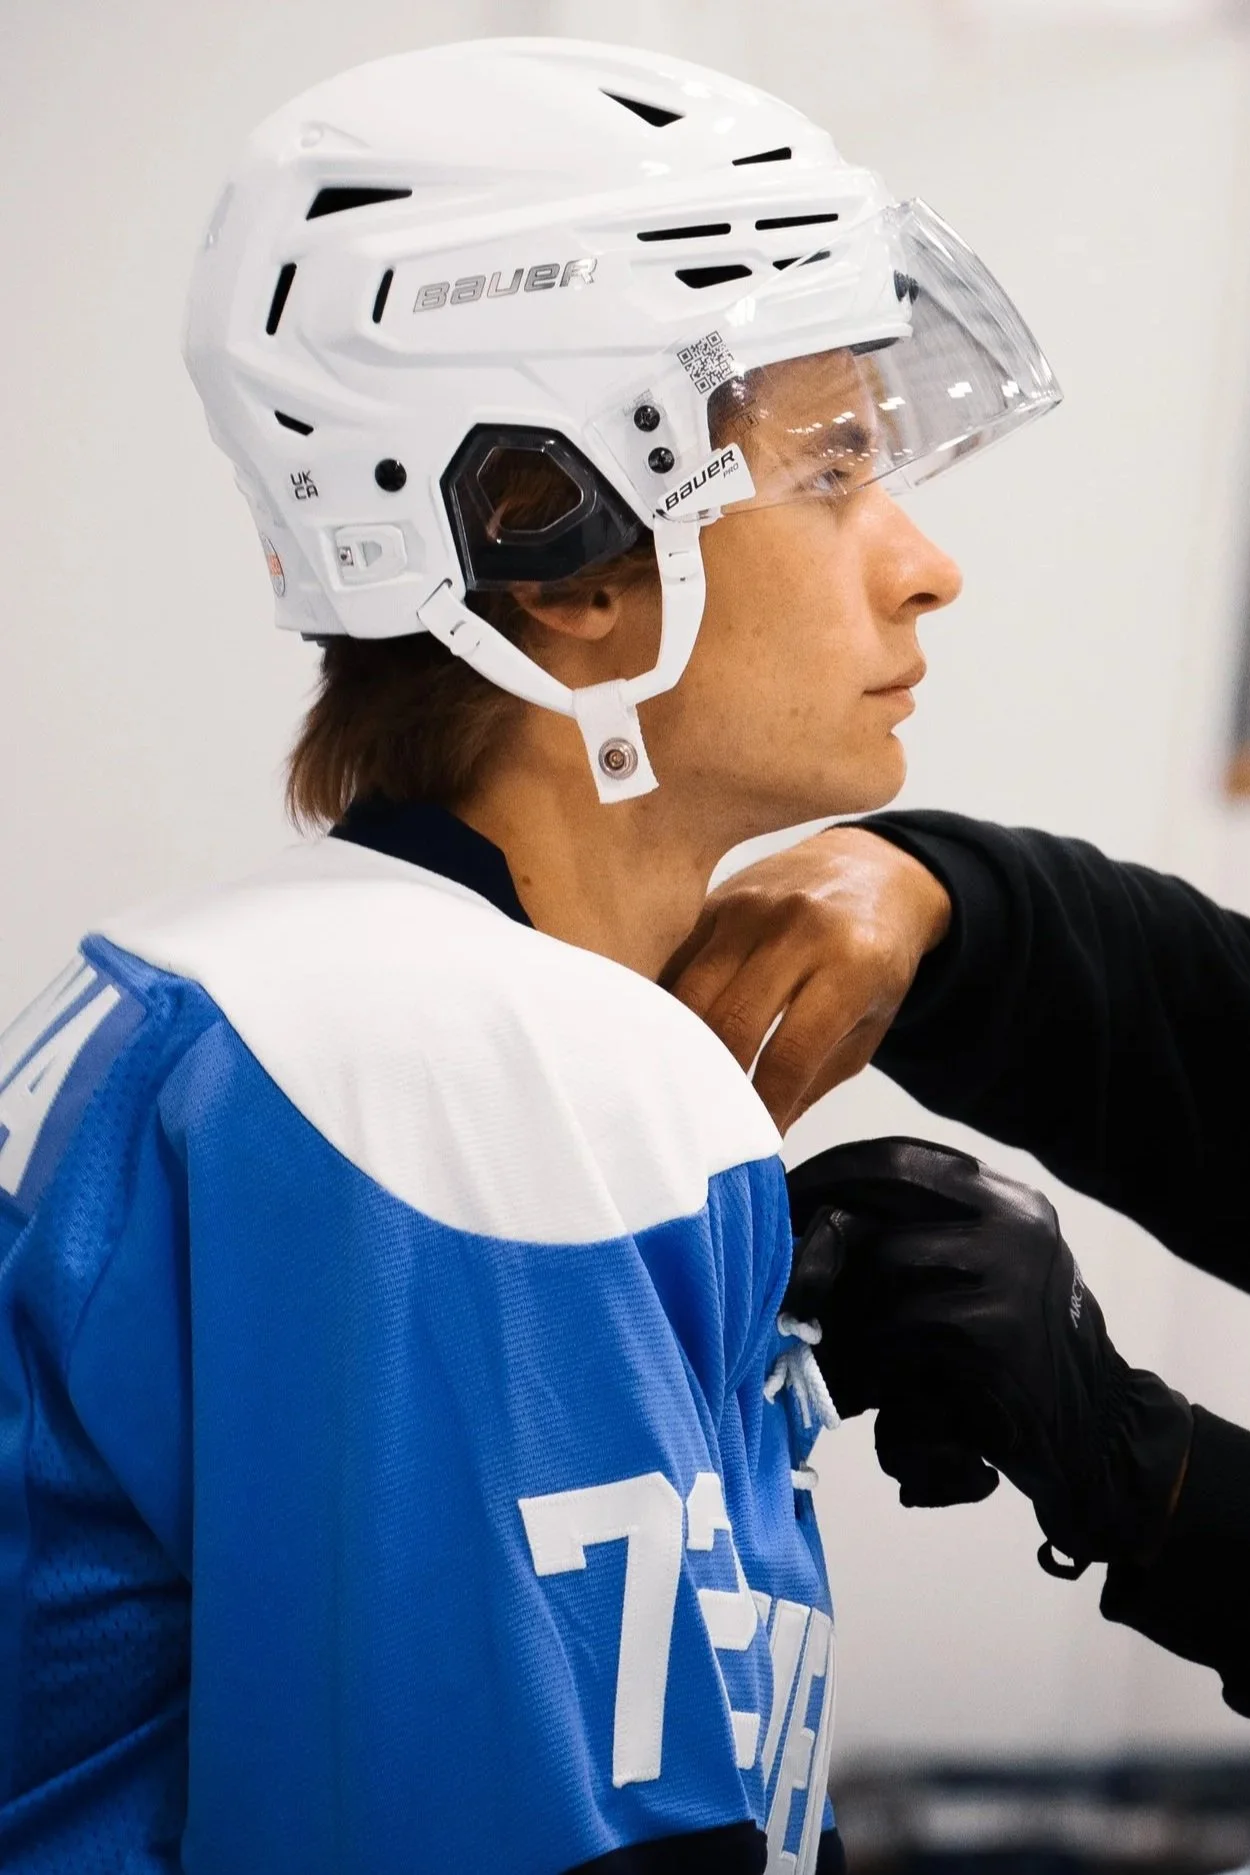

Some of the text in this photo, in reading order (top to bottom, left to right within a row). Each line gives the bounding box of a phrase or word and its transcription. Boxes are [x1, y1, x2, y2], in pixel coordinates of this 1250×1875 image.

[413, 258, 597, 312] BAUER
[290, 470, 313, 486] UK
[723, 463, 739, 478] PRO
[665, 450, 735, 511] BAUER
[295, 485, 318, 500] CA
